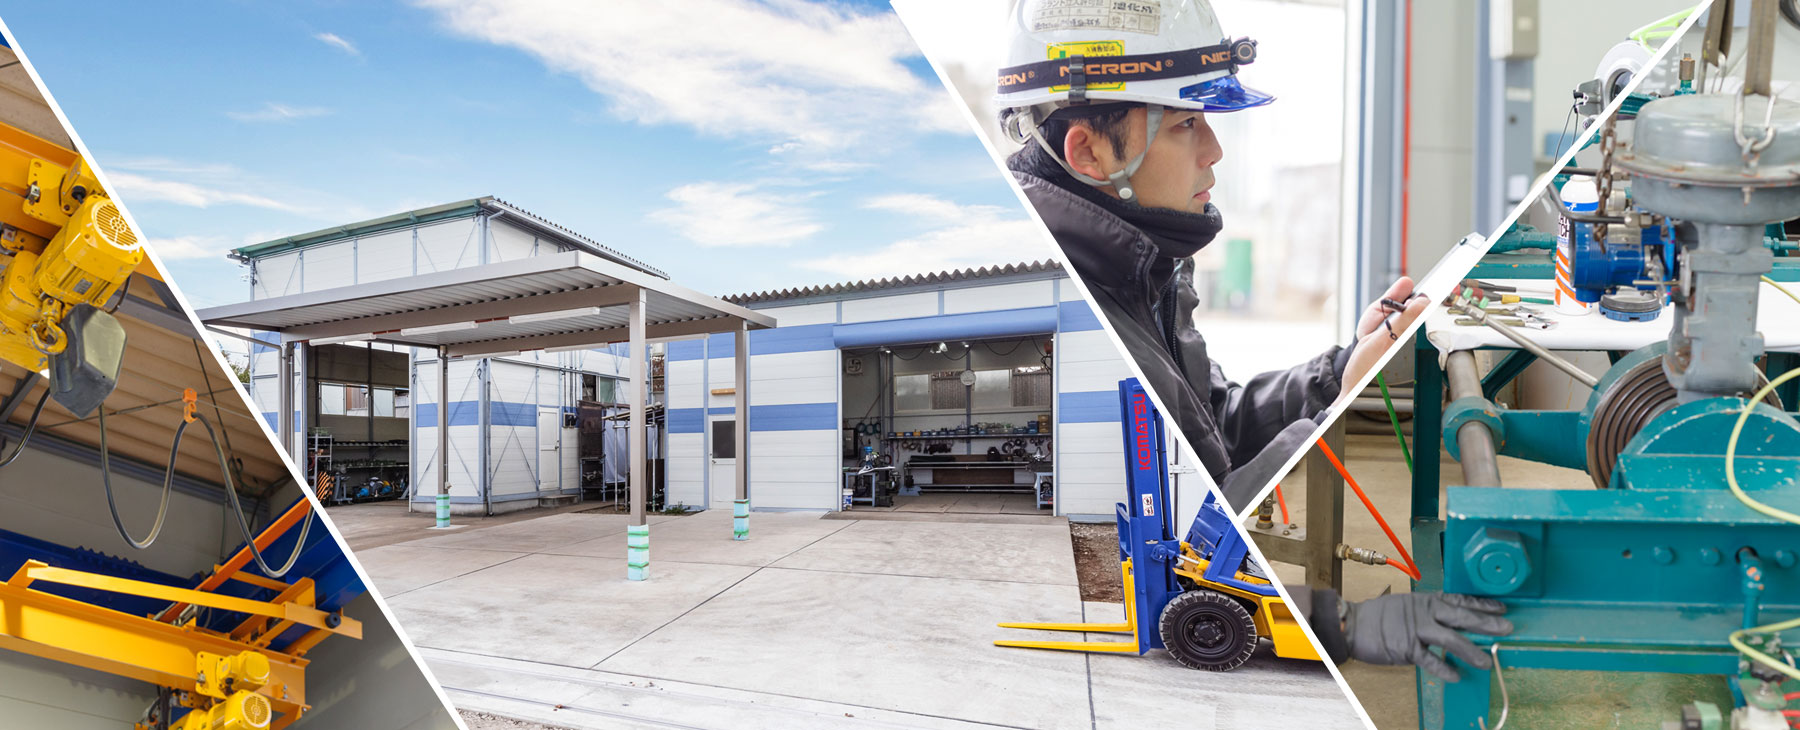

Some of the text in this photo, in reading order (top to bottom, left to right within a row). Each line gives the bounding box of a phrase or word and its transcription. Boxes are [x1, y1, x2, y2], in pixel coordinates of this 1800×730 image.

[1201, 50, 1231, 65] NIC
[1059, 60, 1162, 77] NCRON
[997, 72, 1026, 86] RON
[1133, 393, 1151, 470] KOMATSU
